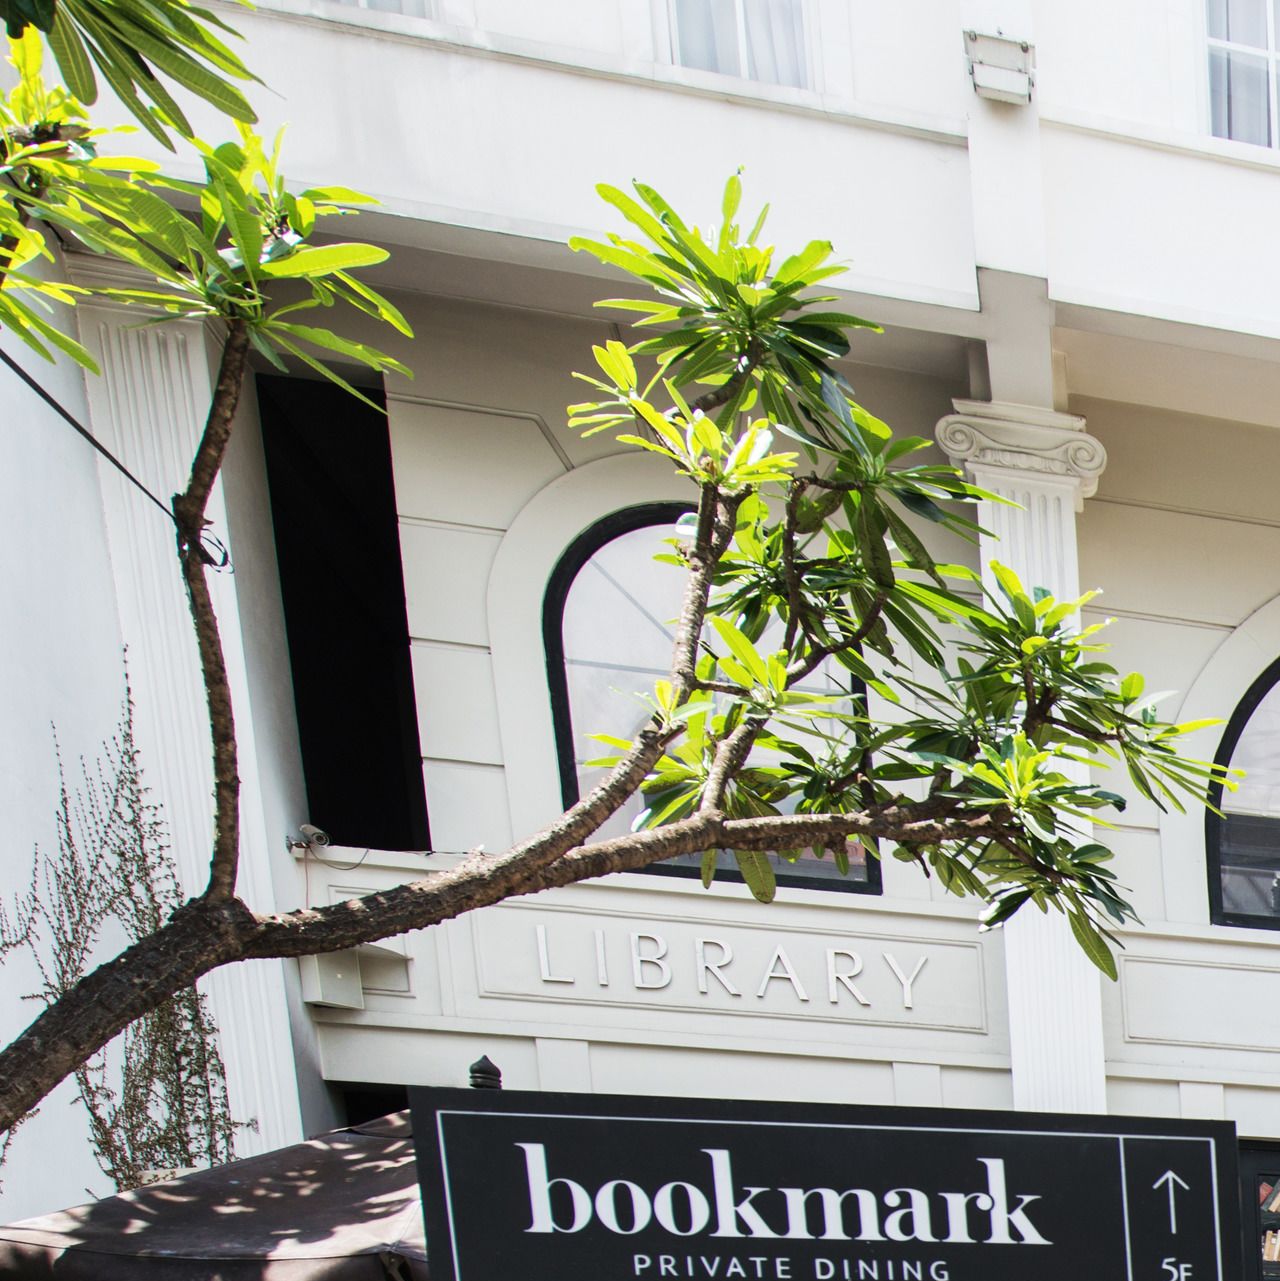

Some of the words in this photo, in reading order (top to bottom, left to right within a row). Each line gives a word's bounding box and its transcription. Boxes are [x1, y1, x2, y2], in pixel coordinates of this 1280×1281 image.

[535, 924, 929, 1009] LIBRARY
[513, 1142, 1053, 1246] bookmark
[633, 1253, 792, 1280] PRIVATE
